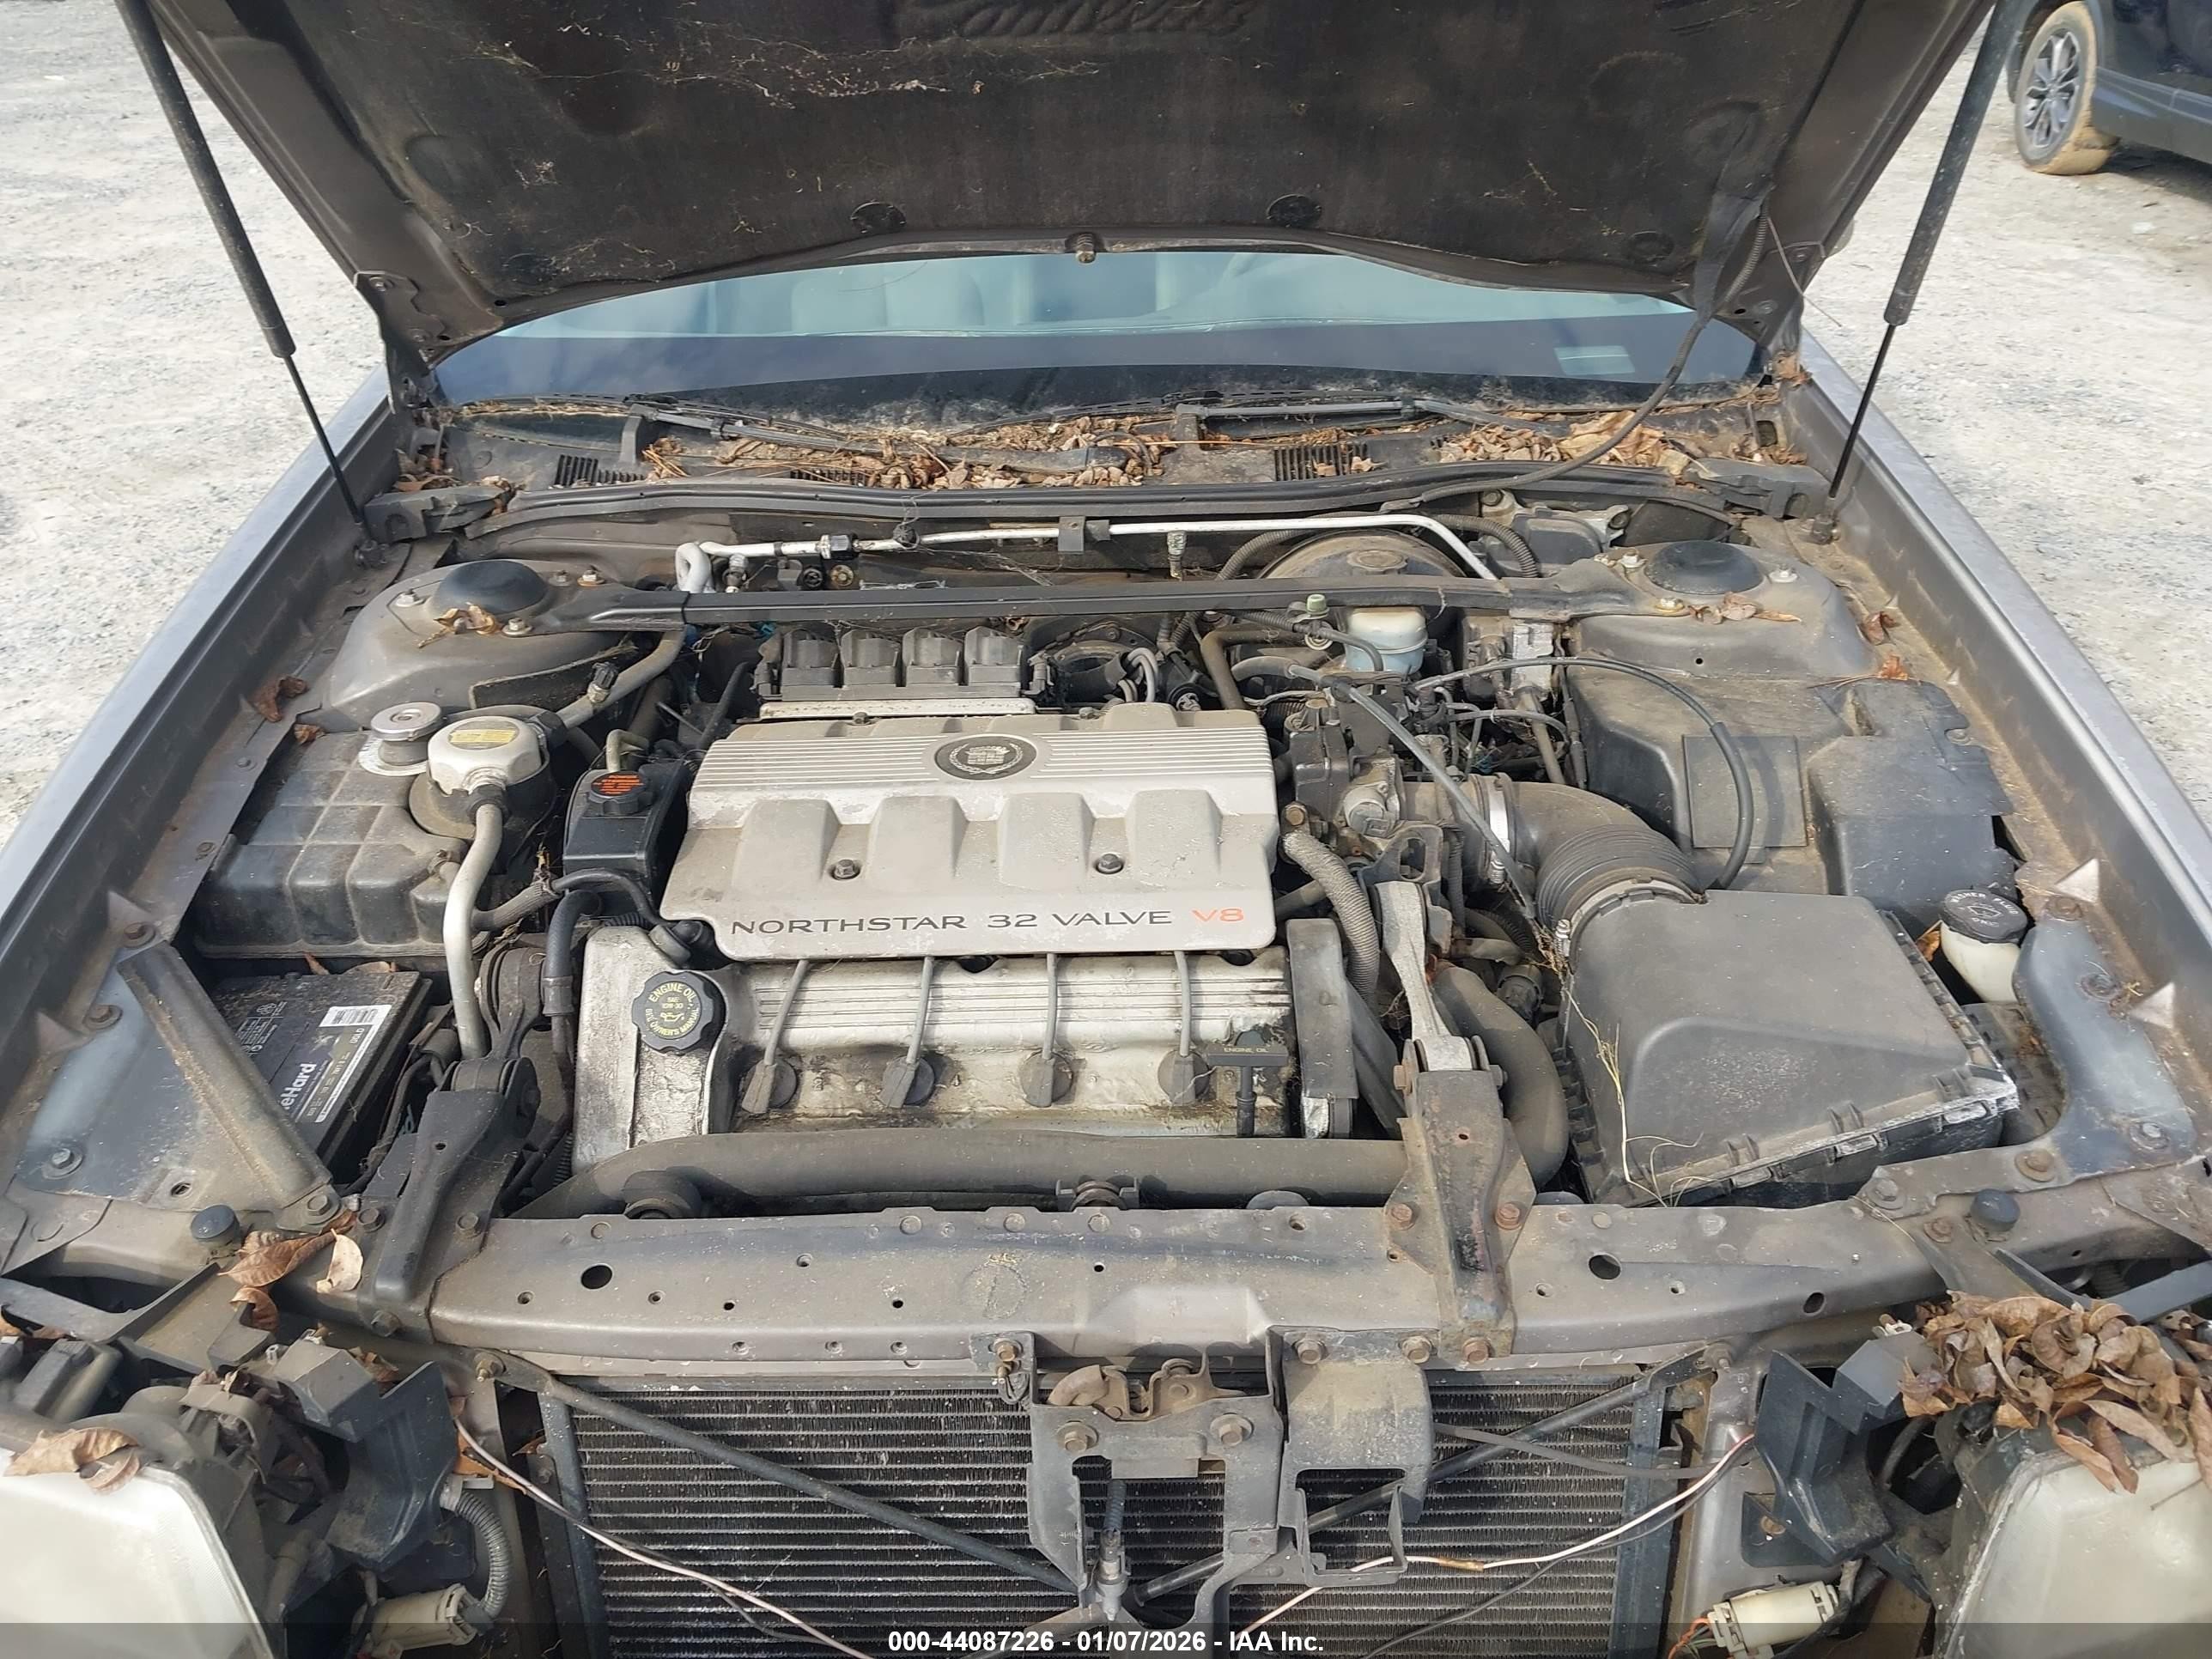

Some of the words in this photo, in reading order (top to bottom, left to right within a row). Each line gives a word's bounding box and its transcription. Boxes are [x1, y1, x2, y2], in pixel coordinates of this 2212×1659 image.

[1993, 898, 2019, 915] FLUID
[730, 915, 969, 935] NORTHSTAR
[987, 914, 1039, 929] 32
[1051, 910, 1173, 927] VALVE
[1192, 908, 1245, 923] V8
[647, 981, 684, 1003] ENGINE
[679, 1007, 700, 1033] MANUAL
[280, 1062, 317, 1109] eHard
